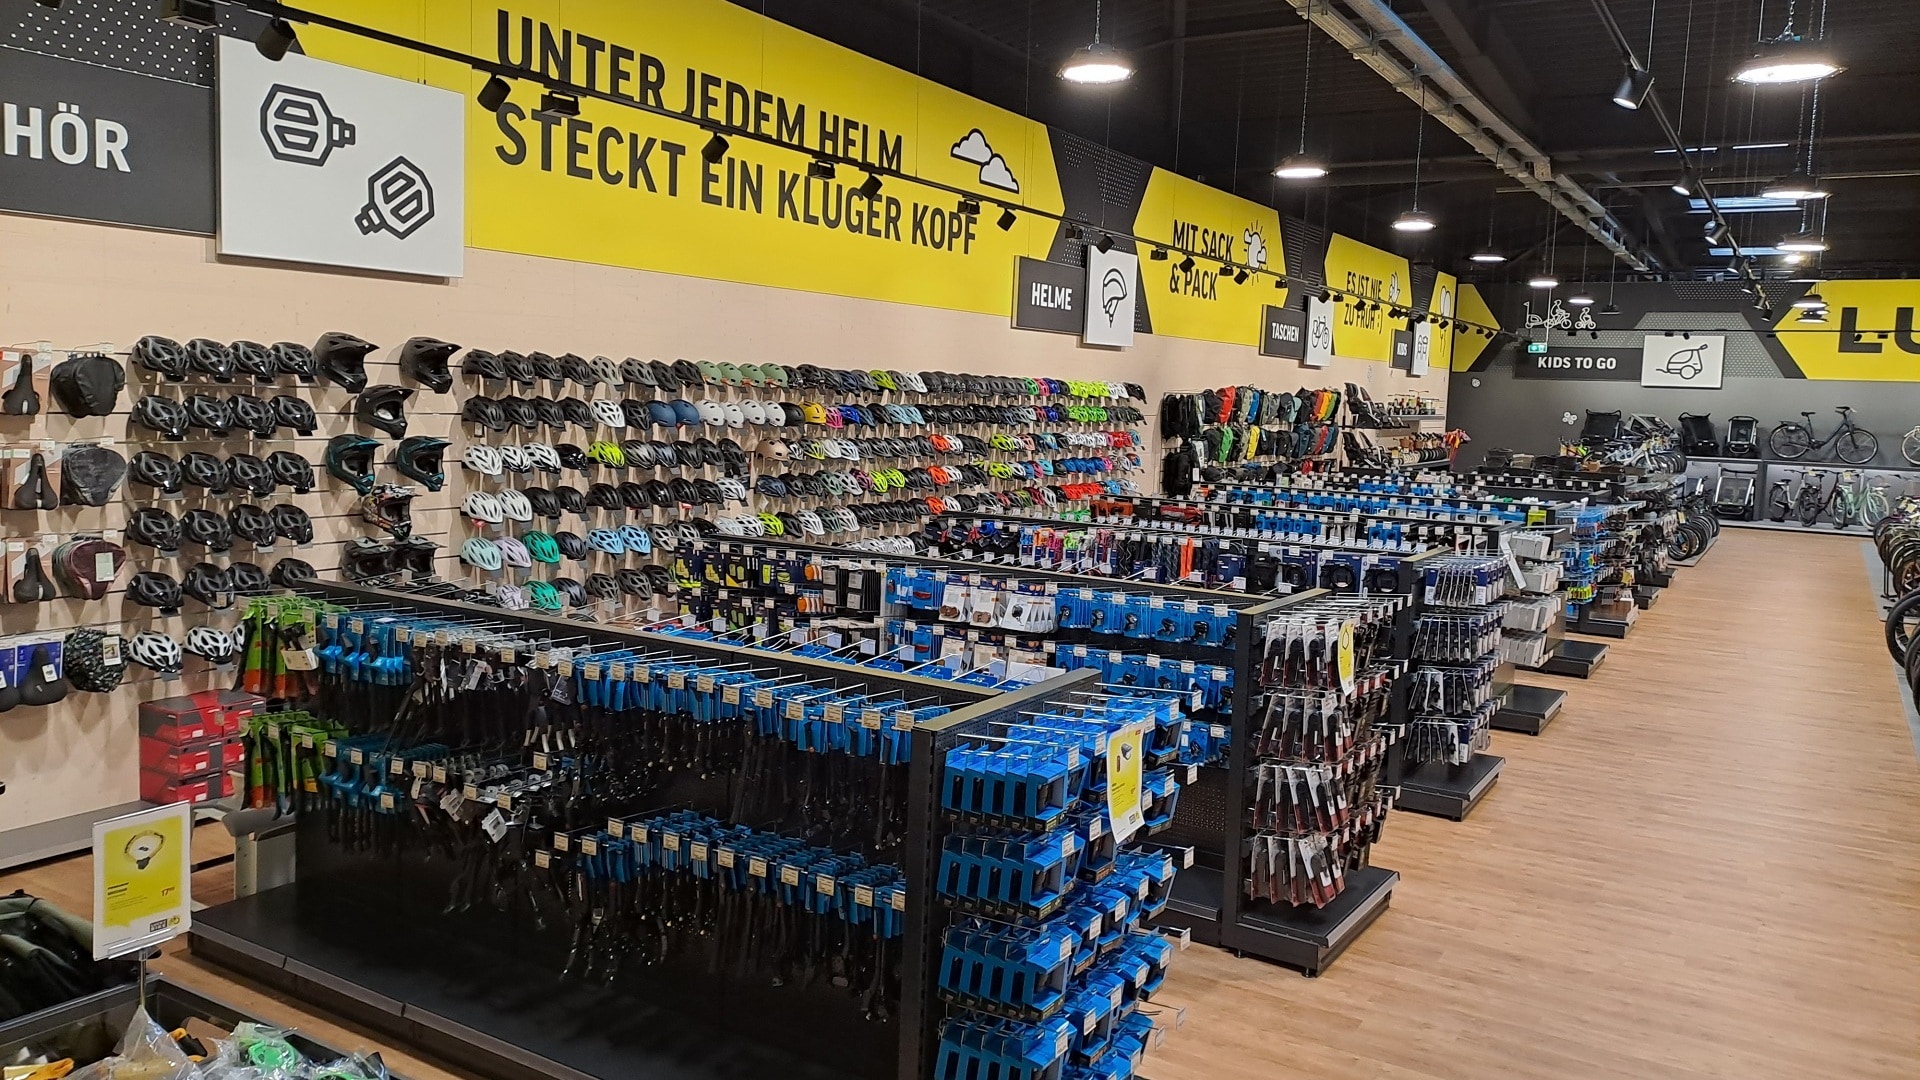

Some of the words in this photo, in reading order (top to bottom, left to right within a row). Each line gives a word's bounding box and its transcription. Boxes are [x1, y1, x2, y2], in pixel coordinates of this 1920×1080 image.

[496, 8, 667, 109] UNTER
[681, 67, 806, 149] JEDEM
[819, 110, 903, 171] HELM
[2, 101, 132, 173] HÖR
[494, 101, 686, 198] STECKT
[701, 153, 763, 215] EIN
[777, 168, 902, 242] KLUGER
[912, 201, 978, 255] KOPF
[1173, 218, 1198, 255] MIT
[1201, 228, 1235, 262] SACK
[1031, 282, 1073, 312] HELME
[1169, 263, 1179, 293] &
[1184, 268, 1218, 301] PACK
[1346, 271, 1357, 295] ES
[1357, 273, 1370, 297] IST
[1371, 277, 1382, 300] NIE
[1271, 323, 1299, 342] TASCHEN
[1344, 302, 1355, 327] ZU
[1356, 304, 1376, 330] FRÜH
[1537, 356, 1572, 369] KIDS
[1574, 357, 1593, 369] TO
[1596, 357, 1617, 370] GO
